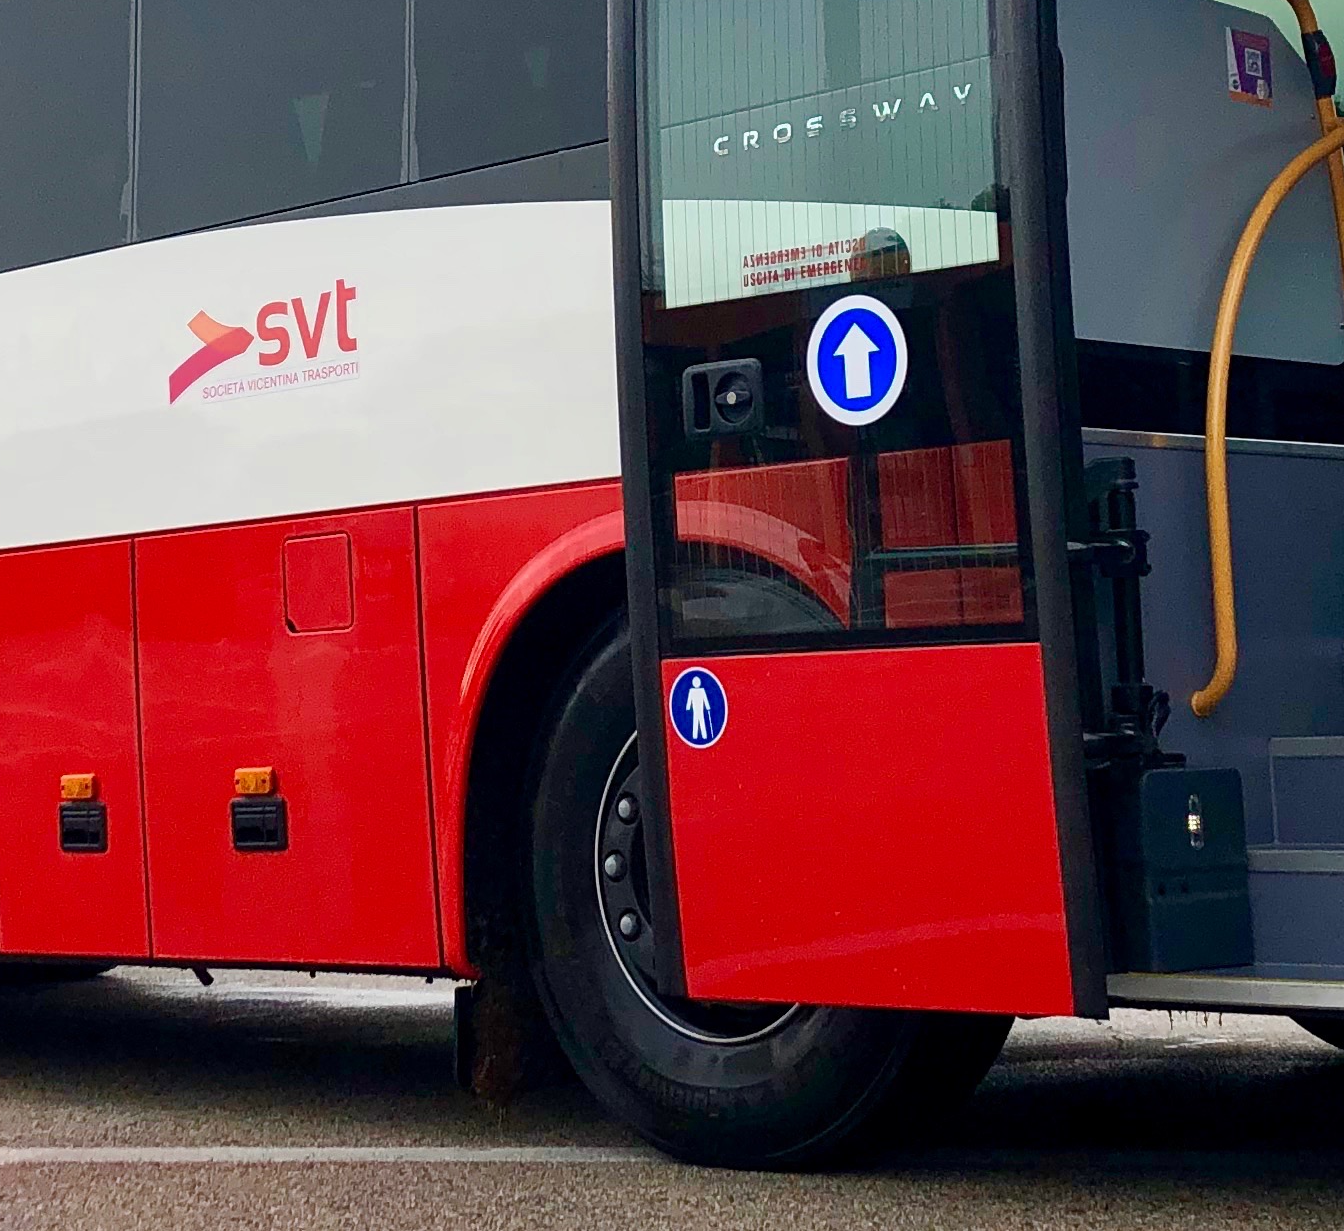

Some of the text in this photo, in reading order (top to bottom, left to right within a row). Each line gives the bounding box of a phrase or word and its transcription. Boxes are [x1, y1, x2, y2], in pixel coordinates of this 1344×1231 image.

[713, 83, 972, 156] CROSSWAY
[743, 270, 780, 288] USCITA
[784, 268, 795, 281] DI
[256, 278, 358, 366] svt
[247, 372, 299, 391] VICENTINA
[302, 362, 359, 383] TRASPORTI
